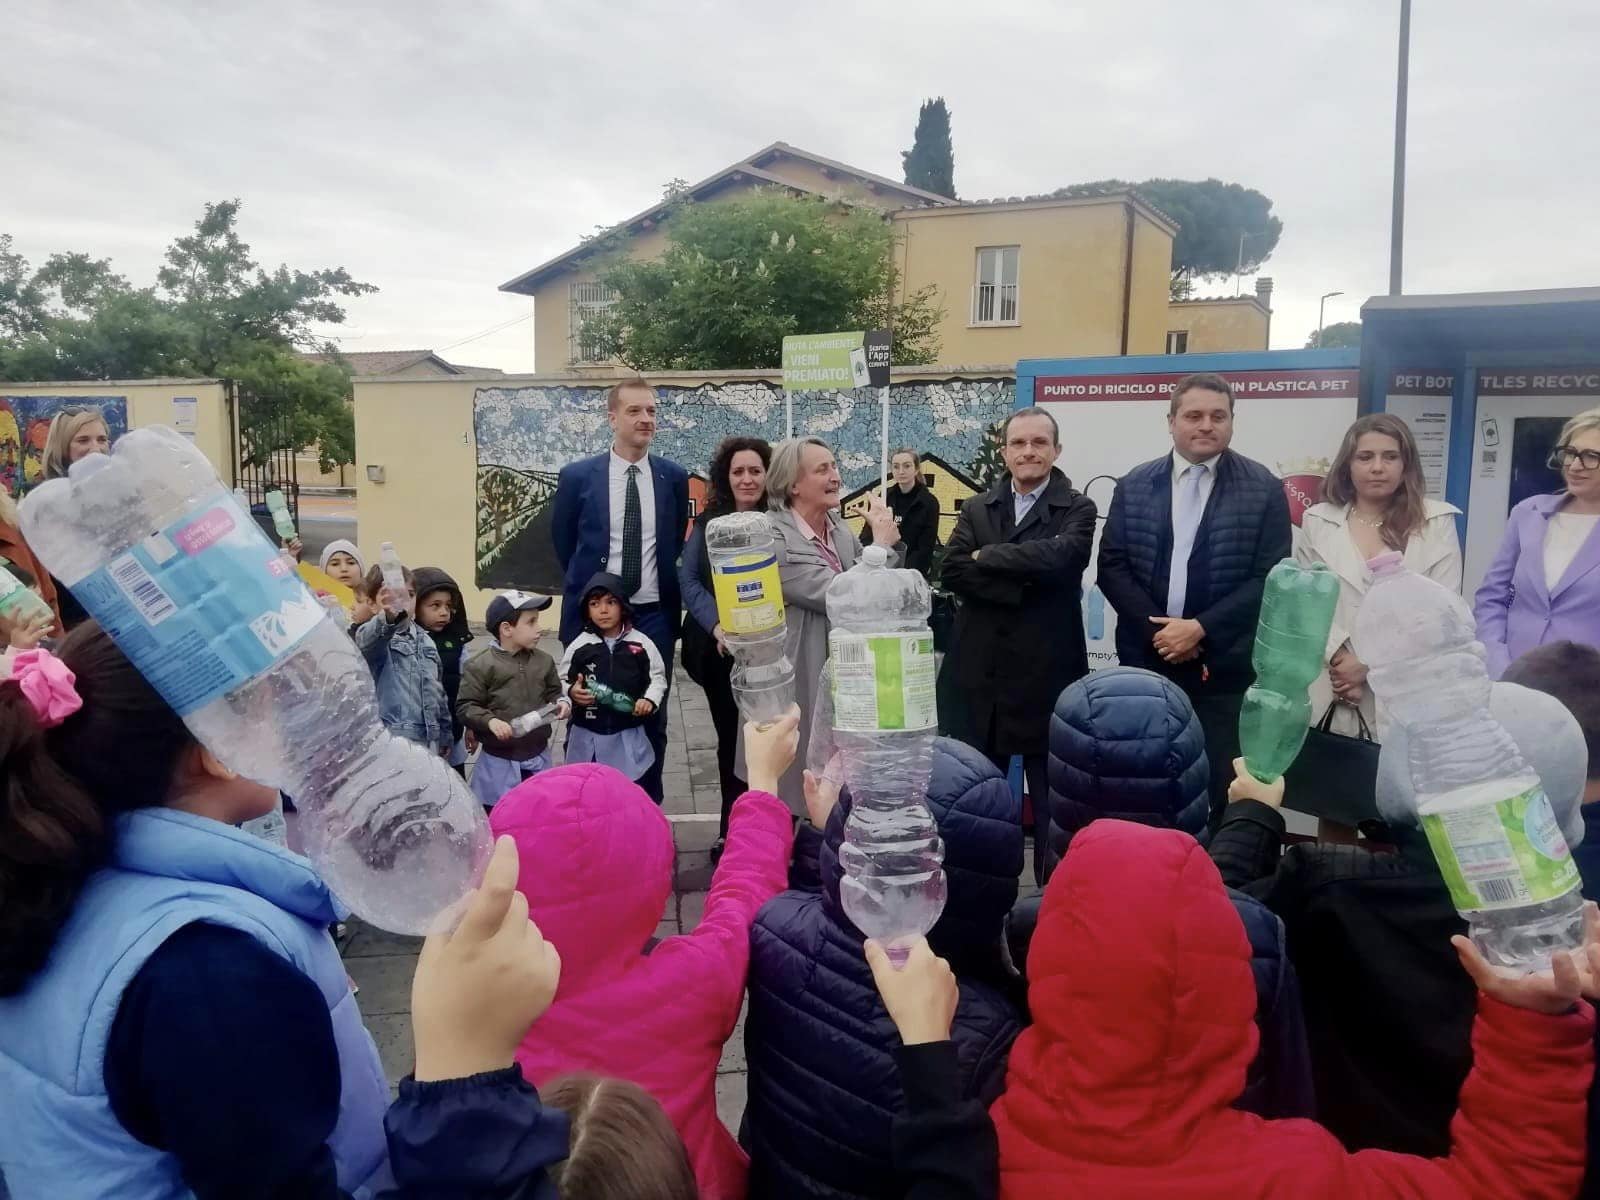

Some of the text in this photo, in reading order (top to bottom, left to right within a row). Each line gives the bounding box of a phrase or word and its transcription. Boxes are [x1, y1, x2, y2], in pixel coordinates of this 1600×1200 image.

[791, 353, 819, 366] VIENI
[784, 368, 849, 382] PREMIATO!
[1395, 375, 1454, 388] PET BOT
[1249, 380, 1317, 392] PLASTICA
[1321, 380, 1350, 391] PET
[1480, 375, 1527, 389] TLES
[1044, 385, 1086, 396] PUNTO
[1088, 385, 1102, 395] DI
[1105, 384, 1155, 395] RICICLO
[1087, 651, 1119, 661] mpty?
